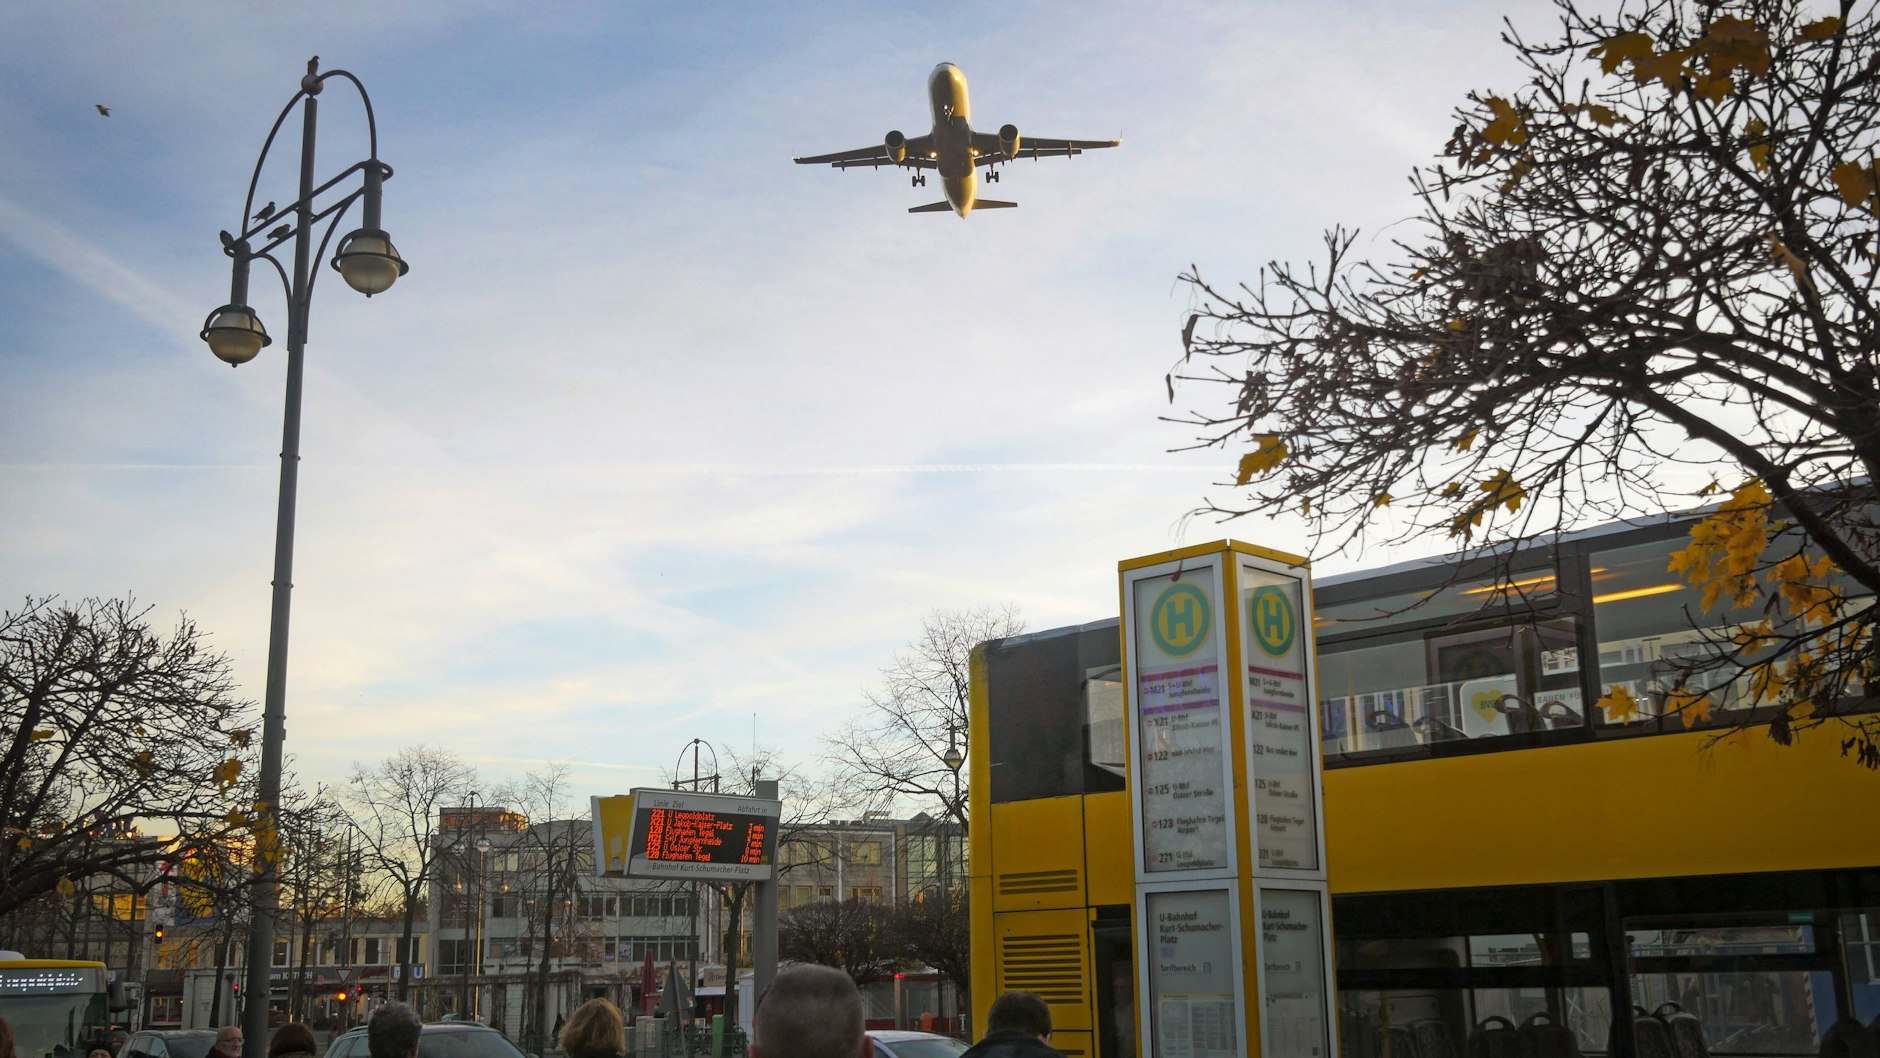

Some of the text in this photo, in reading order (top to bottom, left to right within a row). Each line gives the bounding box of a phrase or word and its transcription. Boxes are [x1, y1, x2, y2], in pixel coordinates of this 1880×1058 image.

[1167, 598, 1194, 641] H
[1263, 598, 1284, 641] H
[1150, 684, 1165, 695] M21
[1252, 710, 1263, 721] X21
[1153, 717, 1168, 726] X21
[1253, 745, 1264, 755] 122
[1154, 751, 1168, 760] 122
[1255, 779, 1266, 789] 125
[1154, 785, 1170, 794] 125
[652, 808, 664, 818] 221
[675, 812, 716, 822] Leopoldplatz
[737, 806, 760, 814] Abfahrt
[1158, 819, 1174, 828] 128
[1257, 814, 1268, 824] 128
[650, 817, 664, 826] X21
[674, 820, 734, 830] Jakob-Kaiser-Platz
[753, 824, 765, 832] min
[650, 825, 664, 834] 128
[666, 826, 696, 836] Flughafen
[699, 828, 714, 838] Tegel
[752, 832, 764, 840] min
[646, 841, 660, 850] 125
[648, 833, 662, 842] M21
[665, 834, 677, 843] S+U
[679, 835, 722, 846] Jungfernheide
[750, 840, 762, 848] min
[646, 850, 760, 864] 128 Flughafen Tegel 10 min
[1159, 853, 1173, 862] 221
[1258, 849, 1269, 859] 221
[646, 862, 750, 874] U-Bahnhof Kurt-Schumacher-Platz
[1160, 912, 1198, 922] U-Bahnhof
[1262, 910, 1290, 920] U-Bahnhof
[1160, 922, 1224, 934] Kurt-Schumacher-
[1262, 922, 1308, 932] Kurt-Schumacher-
[1160, 935, 1178, 944] Platz
[1263, 932, 1277, 942] Platz
[1160, 963, 1196, 972] Tarifbereich
